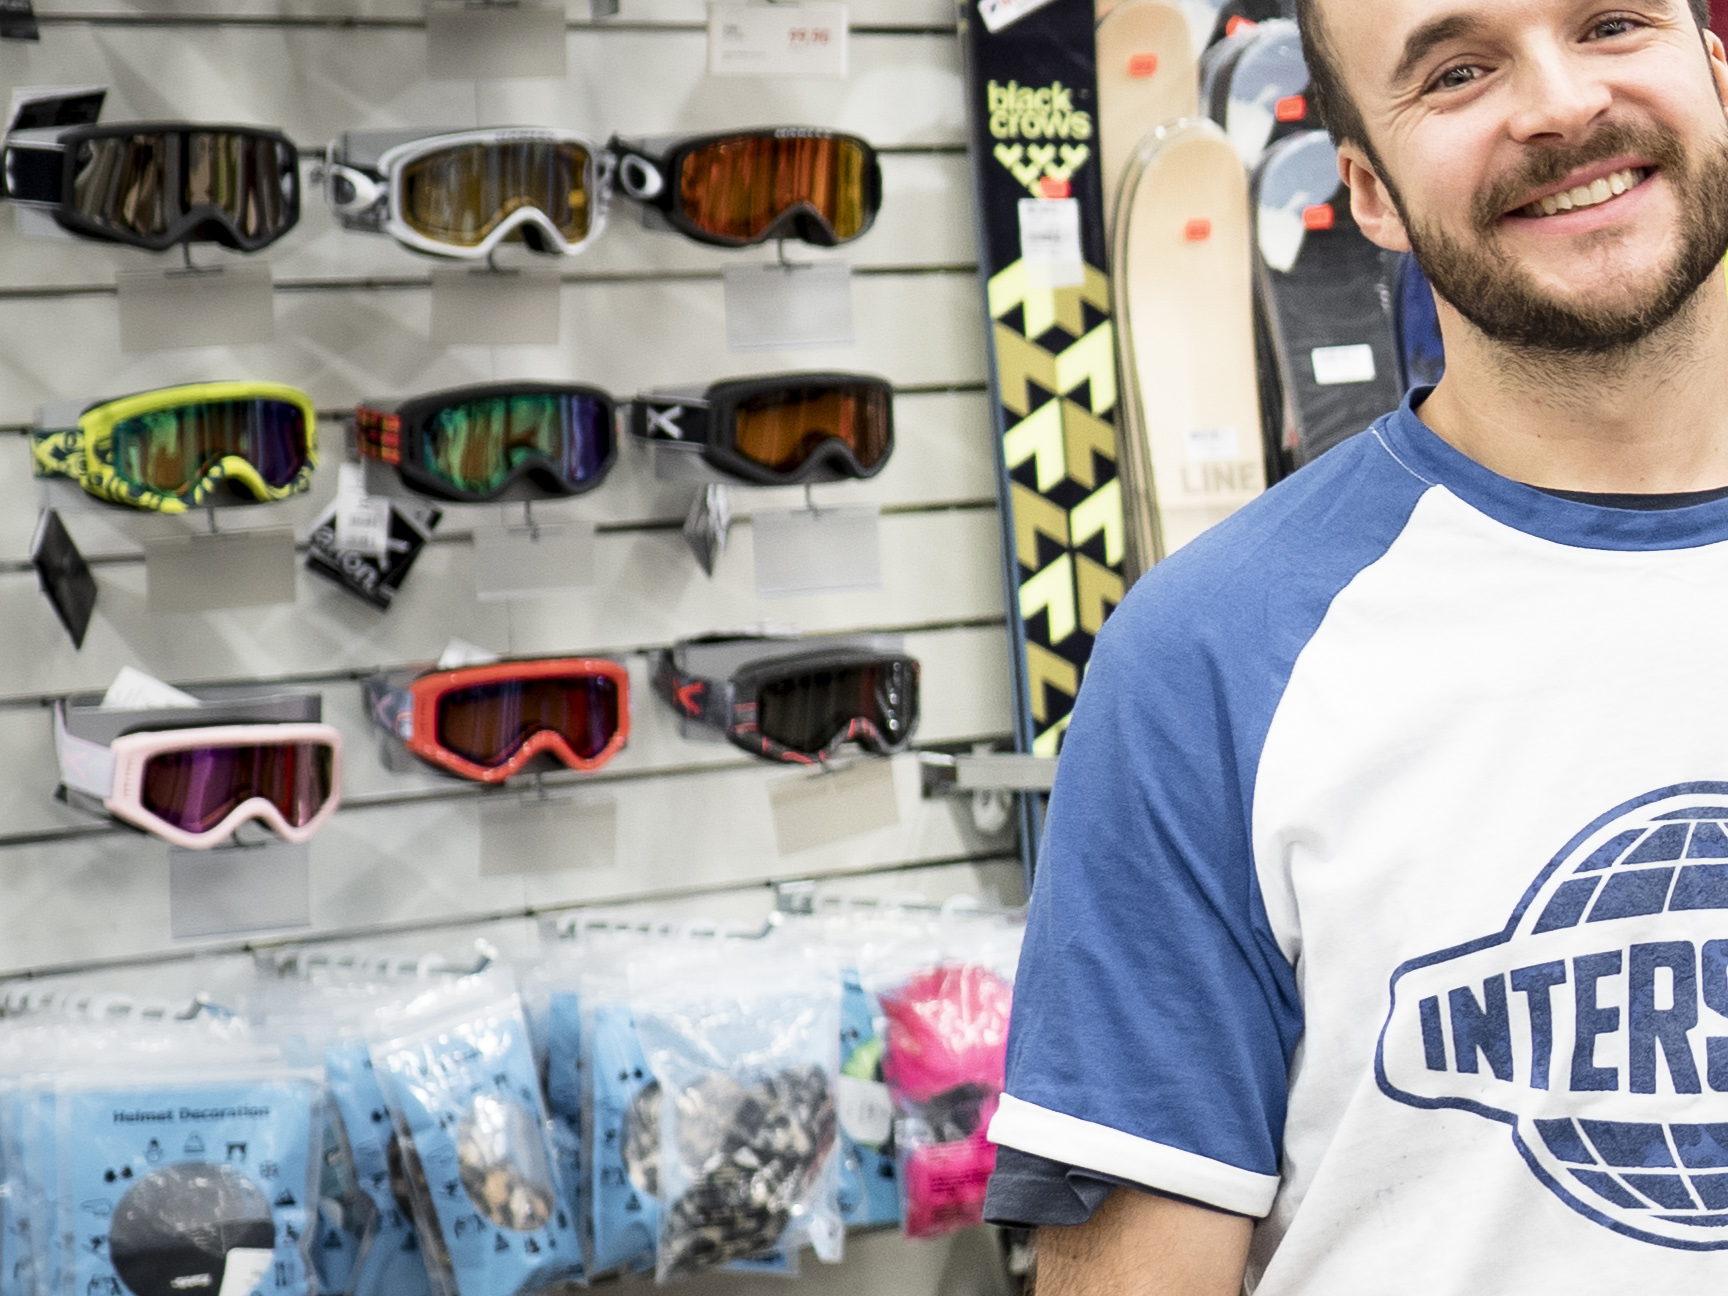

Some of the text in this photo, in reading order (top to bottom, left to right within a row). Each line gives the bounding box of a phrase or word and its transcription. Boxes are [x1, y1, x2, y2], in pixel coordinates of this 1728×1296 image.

[986, 80, 1073, 113] black
[988, 107, 1092, 139] crows
[1180, 460, 1261, 494] LINE
